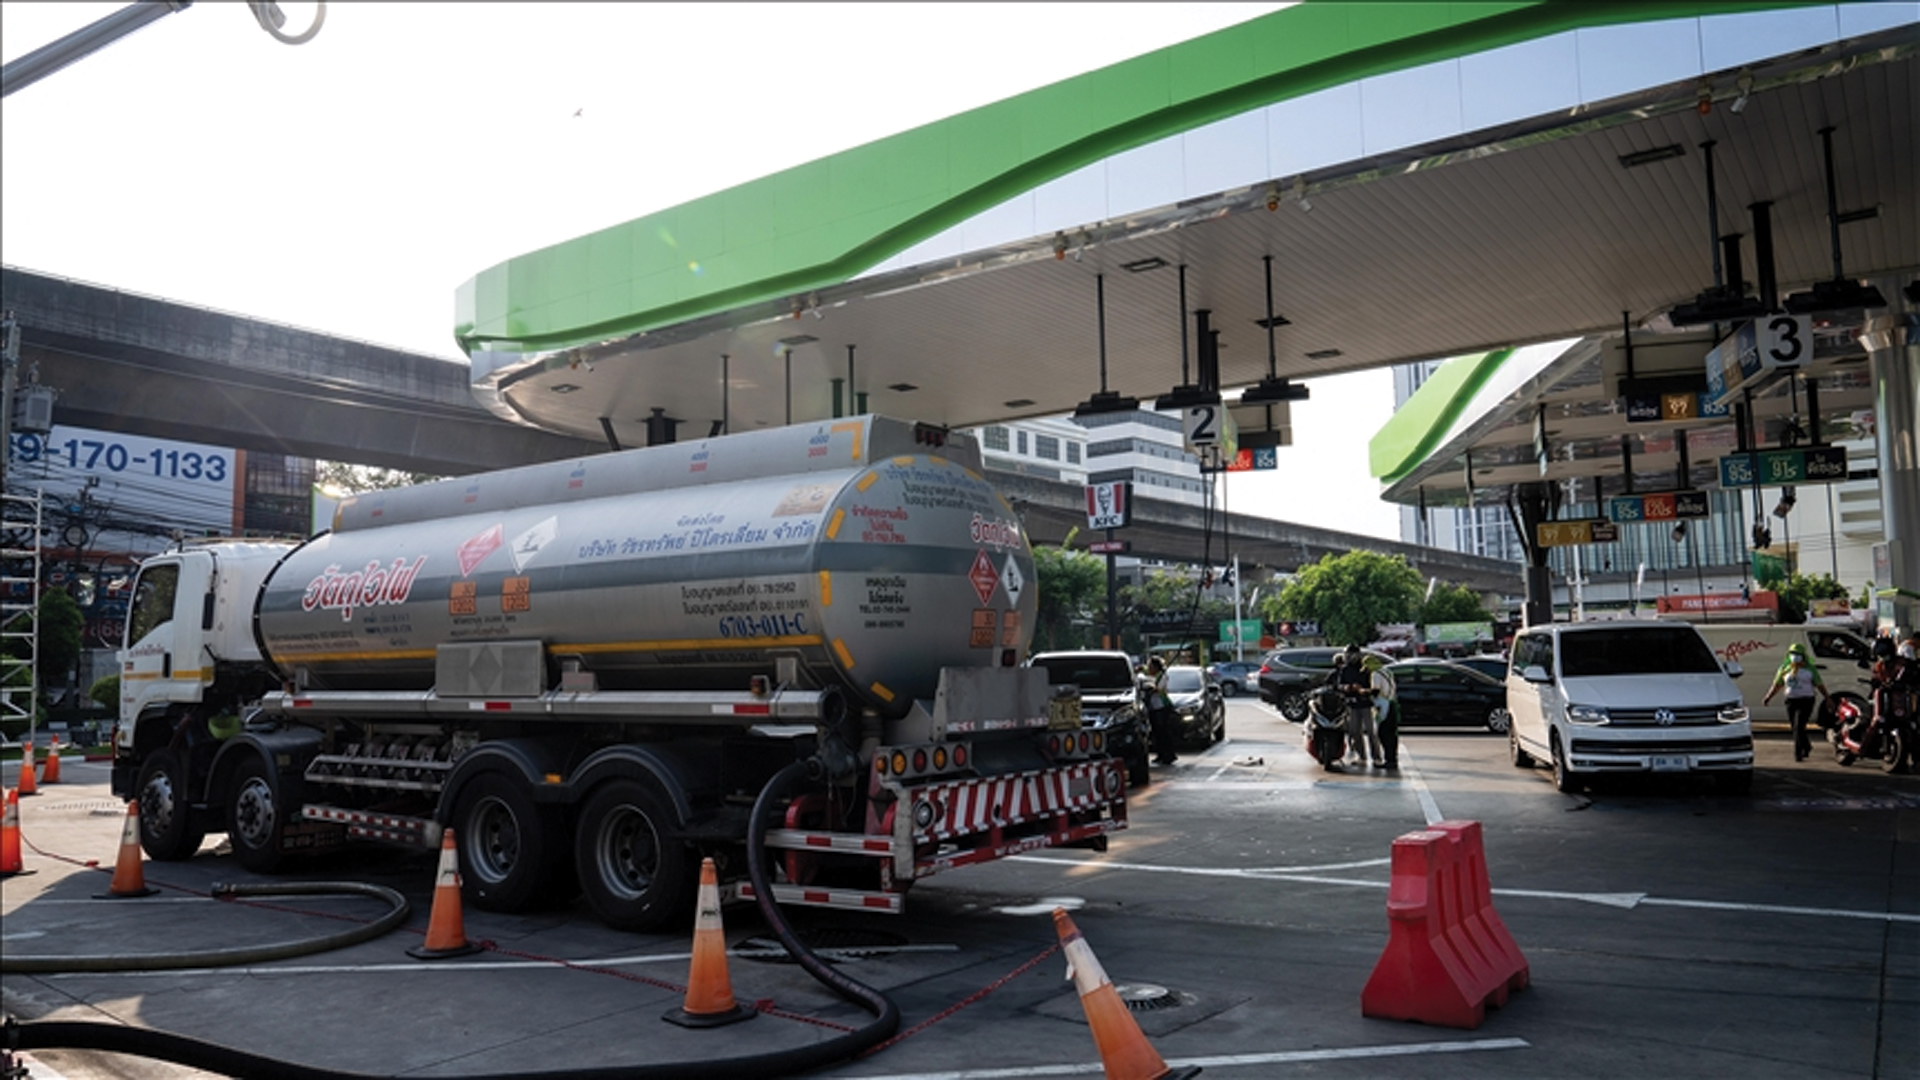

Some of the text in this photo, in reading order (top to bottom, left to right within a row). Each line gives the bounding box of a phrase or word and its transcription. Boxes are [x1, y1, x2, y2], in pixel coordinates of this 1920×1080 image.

[1769, 318, 1801, 362] 3
[1191, 406, 1215, 440] 2
[1093, 515, 1119, 526] KFC
[578, 539, 618, 558] บริษัท
[773, 519, 816, 539] จำกัด
[718, 613, 809, 638] 6703-011-C
